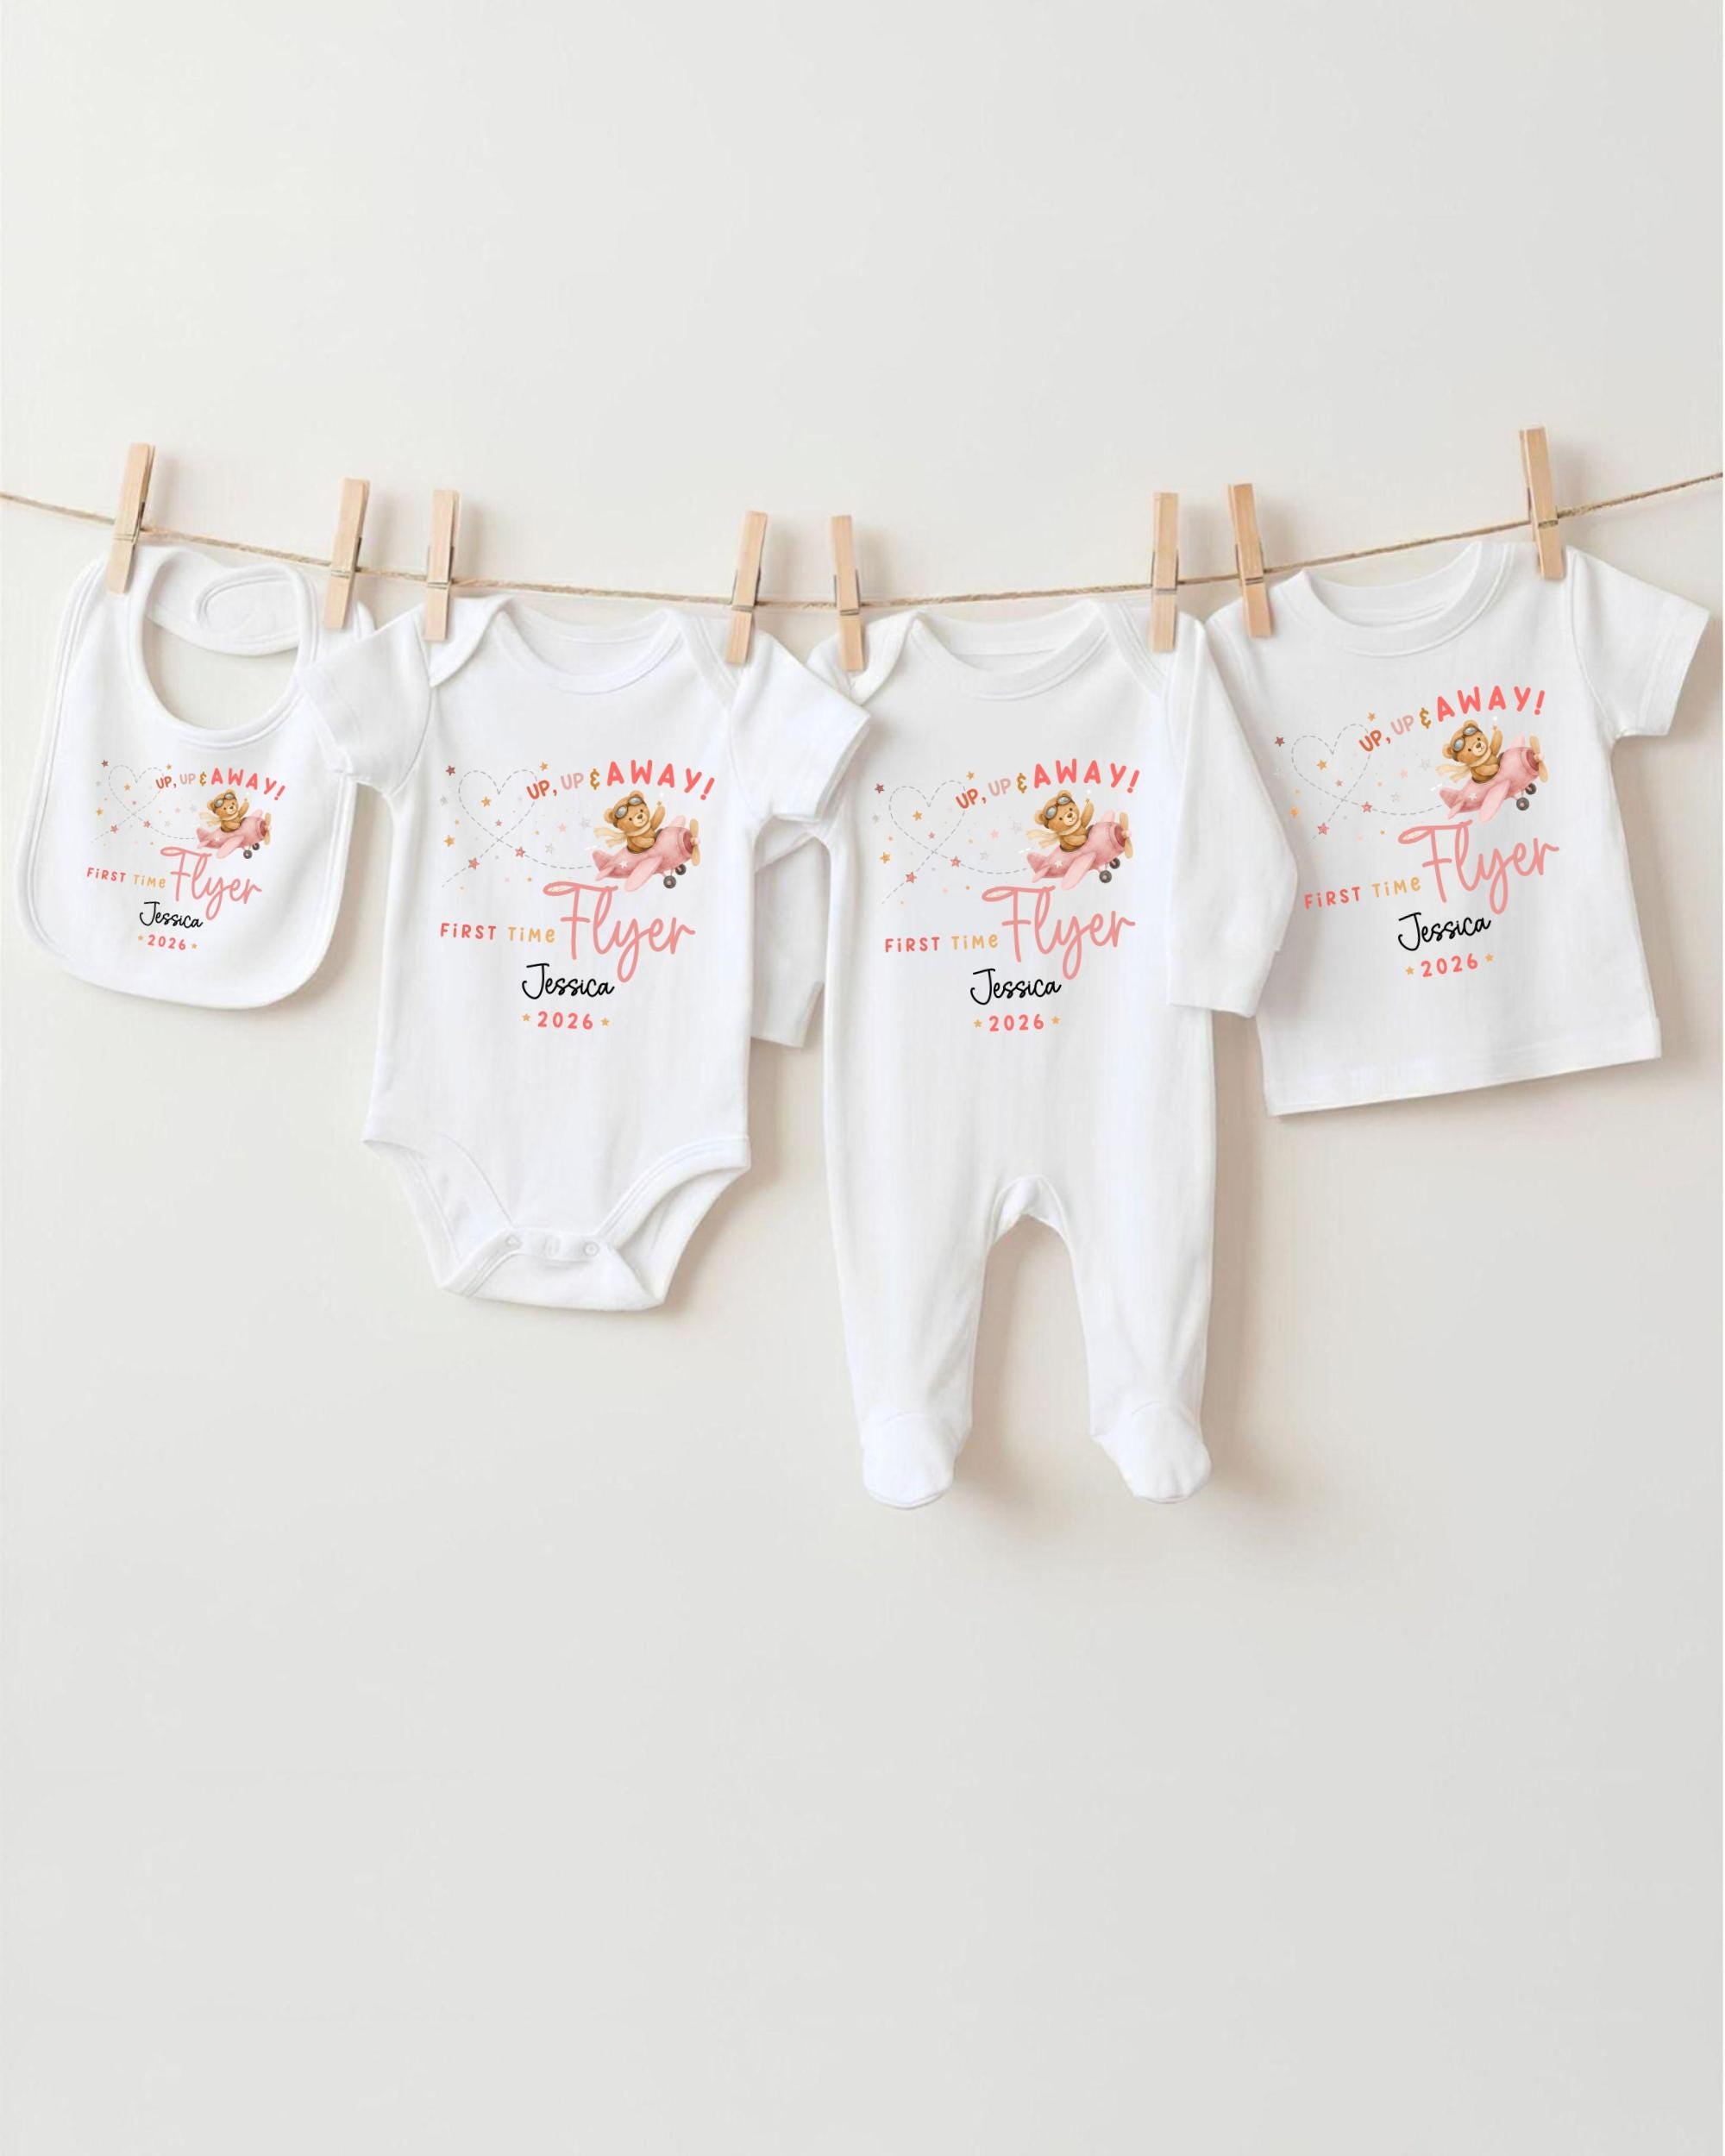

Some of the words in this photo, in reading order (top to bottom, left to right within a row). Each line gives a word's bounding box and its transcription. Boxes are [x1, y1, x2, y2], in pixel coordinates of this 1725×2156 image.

[1359, 730, 1391, 752] UP,
[1390, 715, 1414, 735] UP
[1419, 707, 1432, 729] &
[1437, 686, 1545, 722] AWAY!
[155, 776, 177, 789] UP,
[179, 774, 196, 784] UP
[199, 772, 207, 787] &
[211, 768, 285, 800] AWAY!
[526, 780, 557, 799] UP,
[561, 773, 584, 790] UP
[590, 768, 600, 790] &
[607, 760, 715, 800] AWAY!
[956, 788, 986, 809] UP,
[988, 778, 1011, 796] UP
[1017, 773, 1027, 793] &
[1034, 759, 1139, 793] AWAY!
[160, 846, 262, 920] Flyer
[1397, 819, 1559, 914] Flyer
[140, 901, 204, 928] Jessica
[543, 881, 695, 982] Flyer
[982, 885, 1135, 980] Flyer
[1398, 912, 1490, 951] Jessica
[147, 935, 186, 950] 2026
[522, 962, 614, 999] Jessica
[1421, 953, 1477, 977] 2026
[970, 968, 1062, 1005] Jessica
[537, 1011, 593, 1030] 2026
[989, 1014, 1044, 1032] 2026
